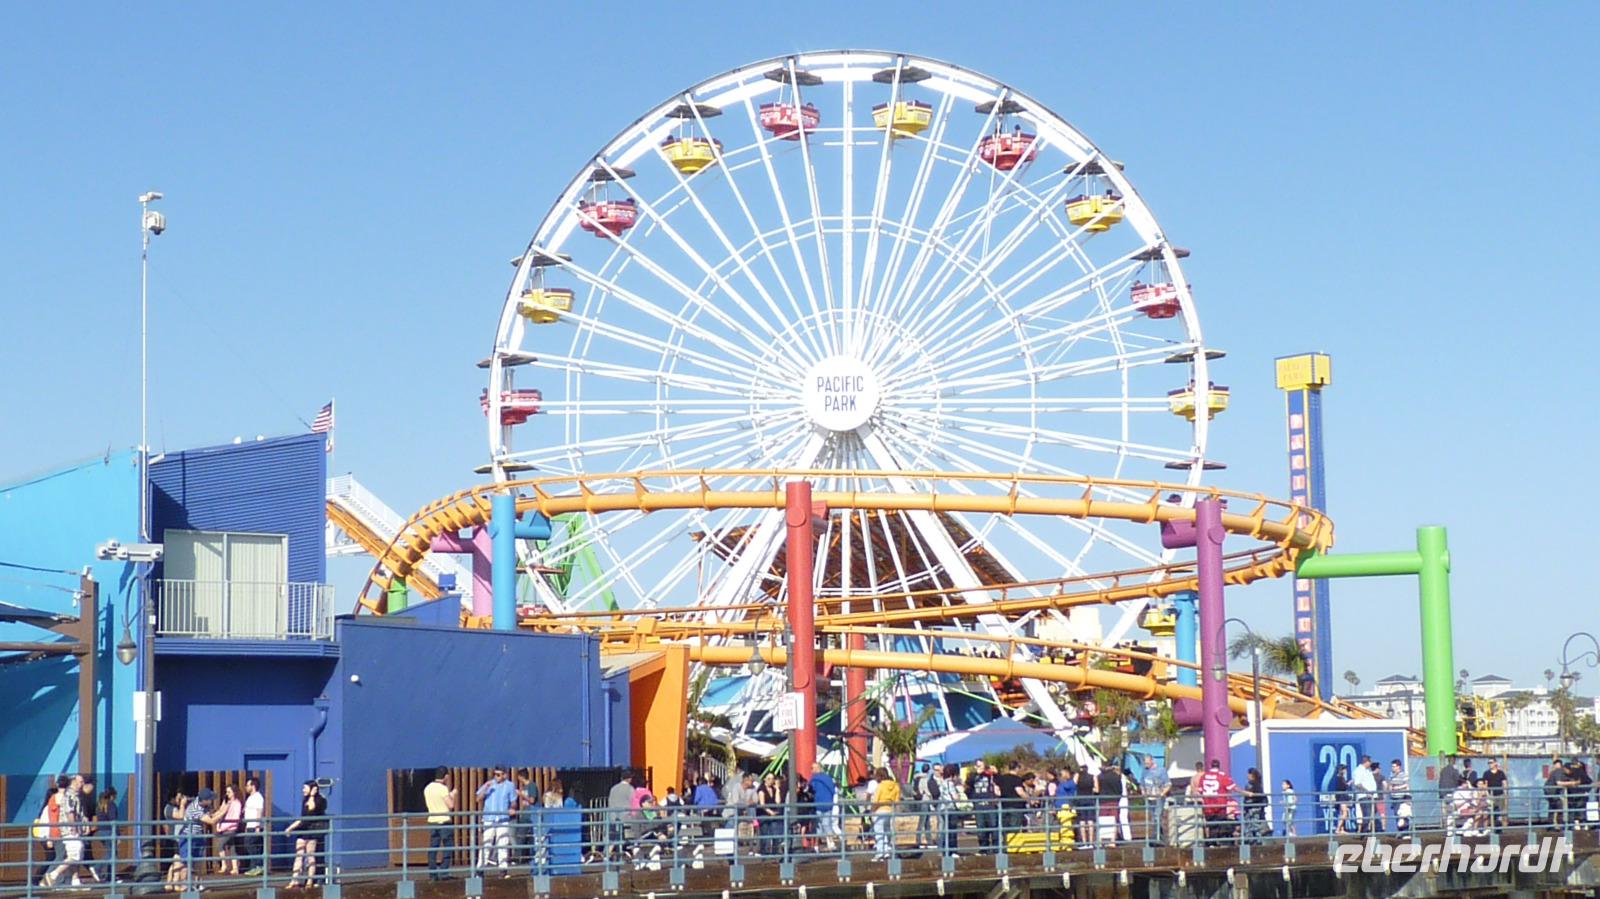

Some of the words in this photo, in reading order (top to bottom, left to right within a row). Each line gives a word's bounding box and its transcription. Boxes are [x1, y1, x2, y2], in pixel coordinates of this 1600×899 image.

[817, 376, 864, 392] PACIFIC
[825, 395, 857, 412] PARK
[1319, 744, 1357, 793] 20
